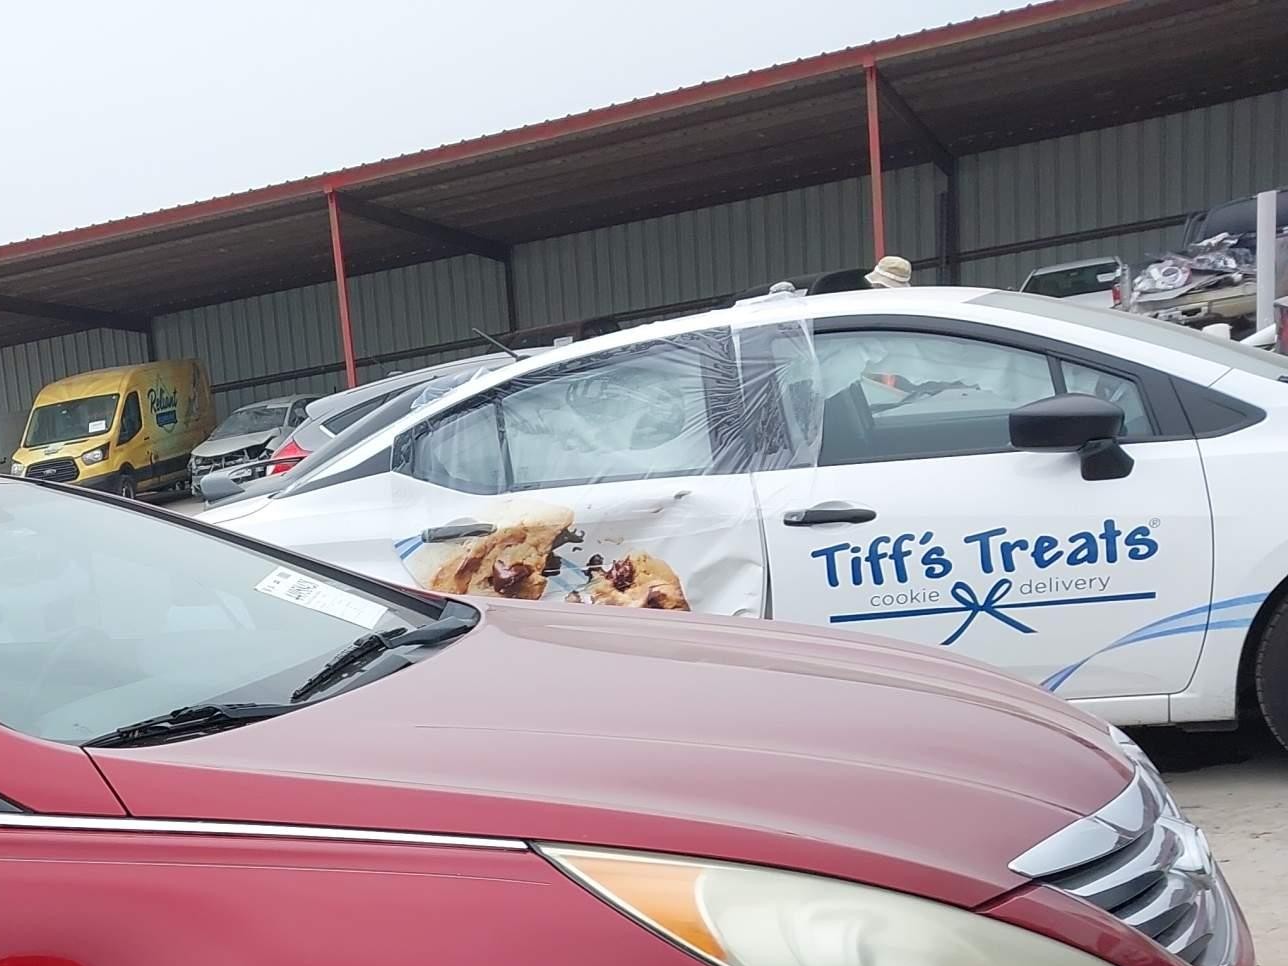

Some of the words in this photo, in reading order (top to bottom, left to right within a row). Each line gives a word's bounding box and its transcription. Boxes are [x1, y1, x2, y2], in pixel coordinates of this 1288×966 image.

[810, 531, 953, 588] Tiff's
[870, 587, 940, 607] cookie
[1019, 575, 1111, 595] delivery
